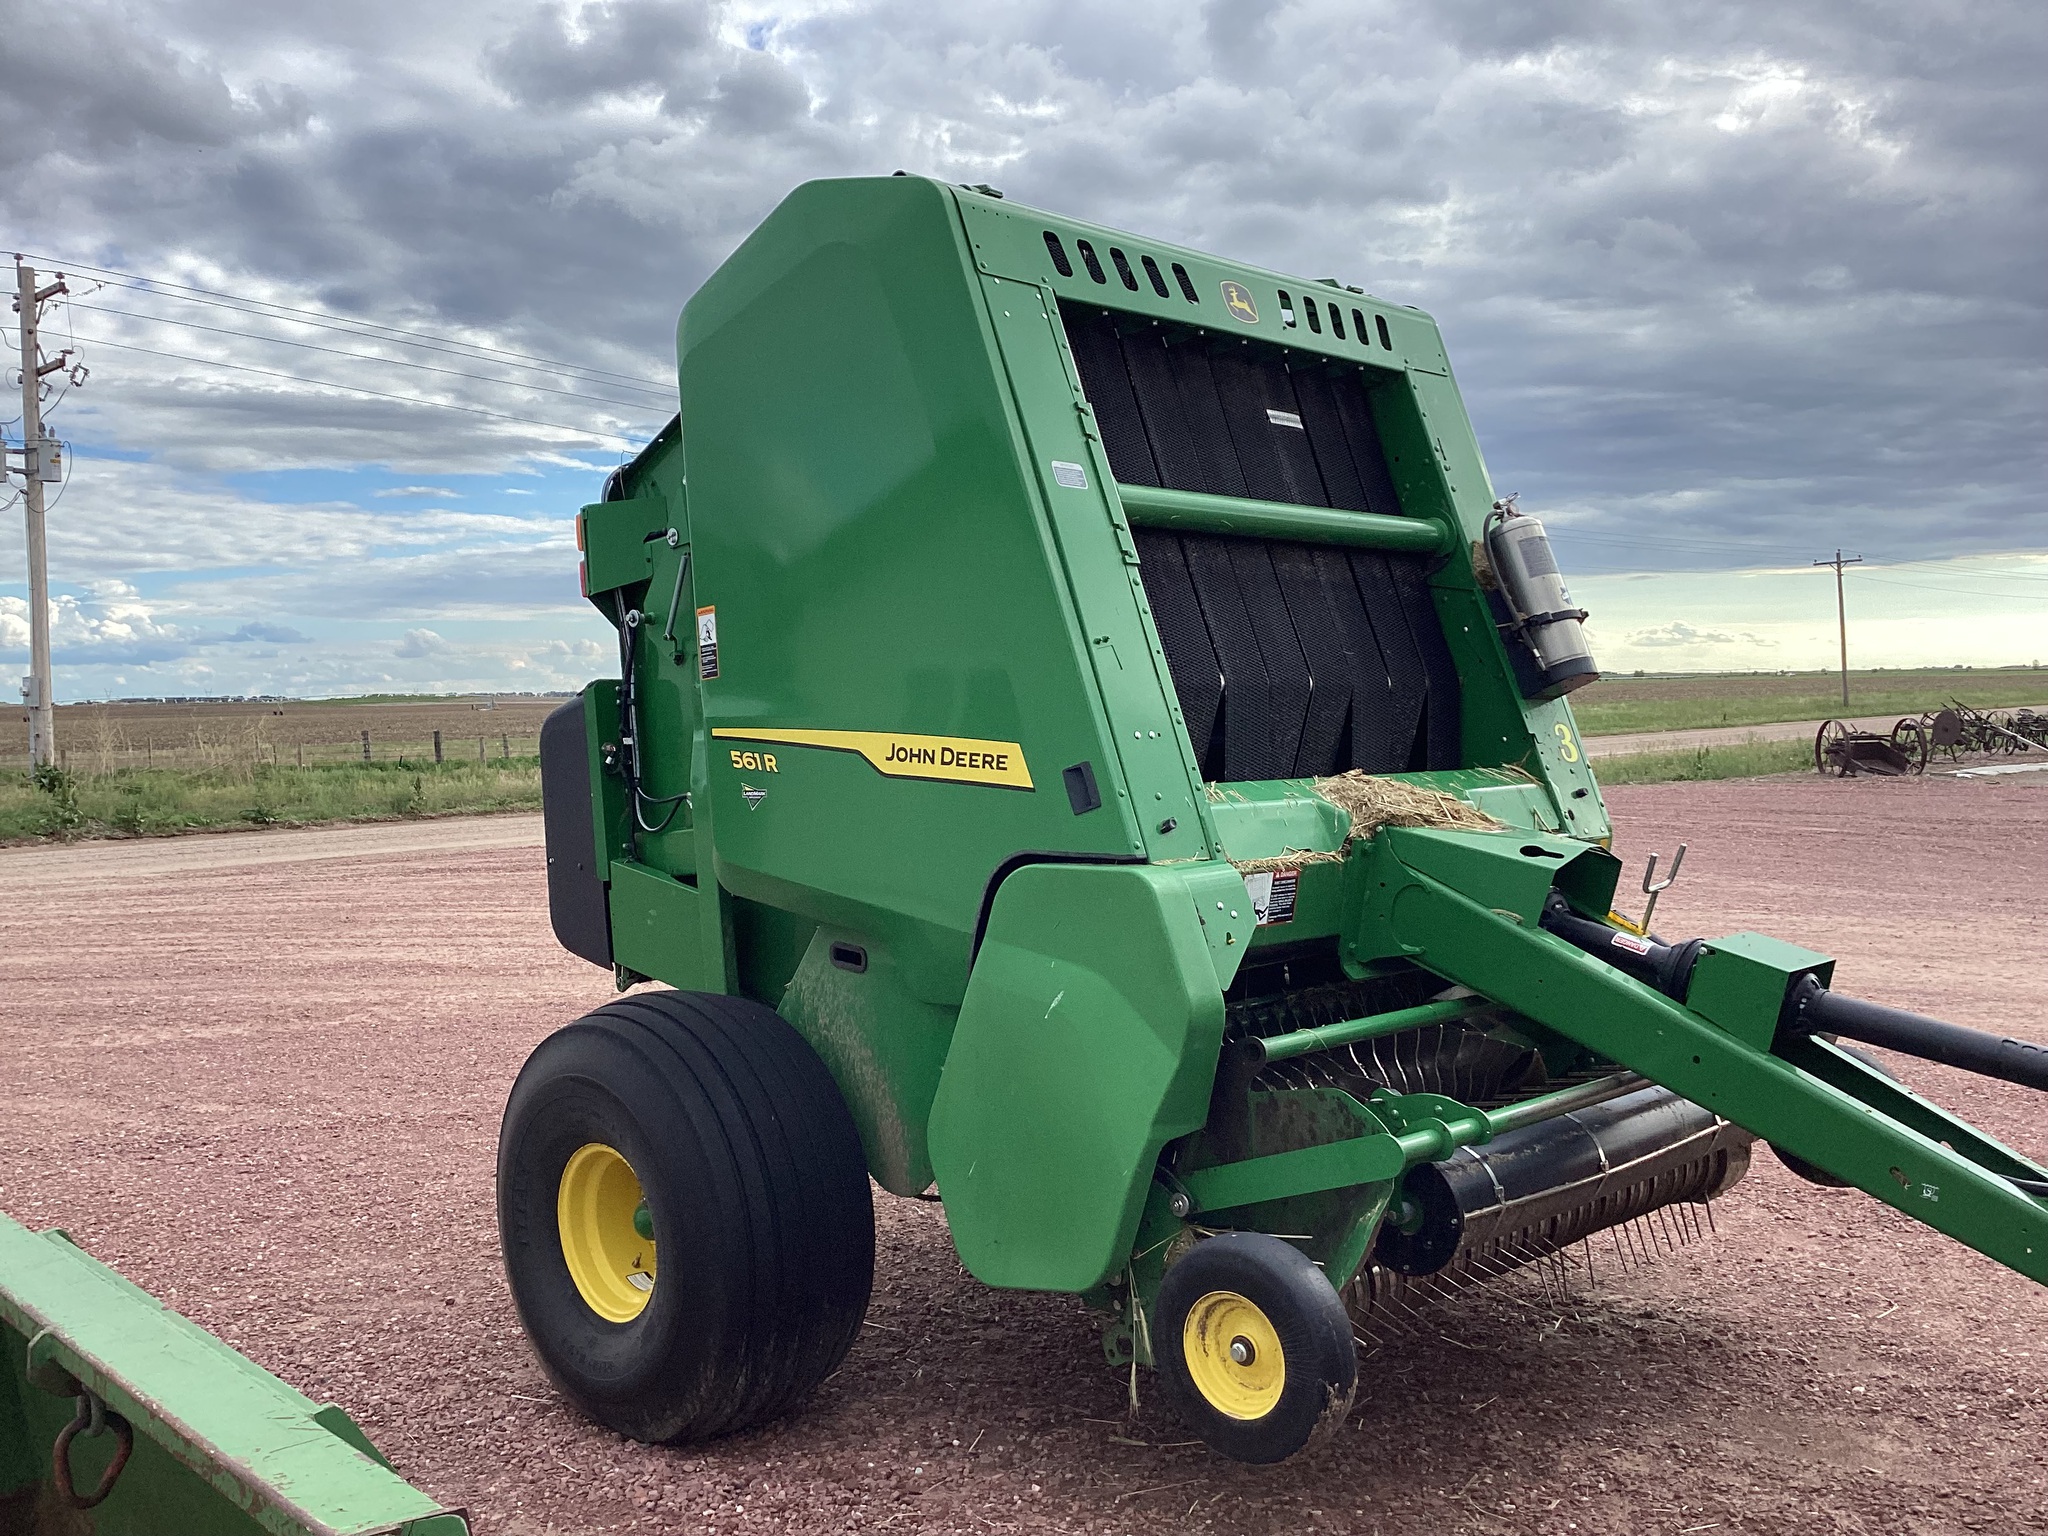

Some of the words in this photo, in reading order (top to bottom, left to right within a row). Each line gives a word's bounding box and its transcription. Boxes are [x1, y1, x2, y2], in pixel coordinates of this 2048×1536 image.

[885, 742, 936, 765] JOHN
[940, 746, 1008, 771] DEERE
[1554, 723, 1578, 763] 3
